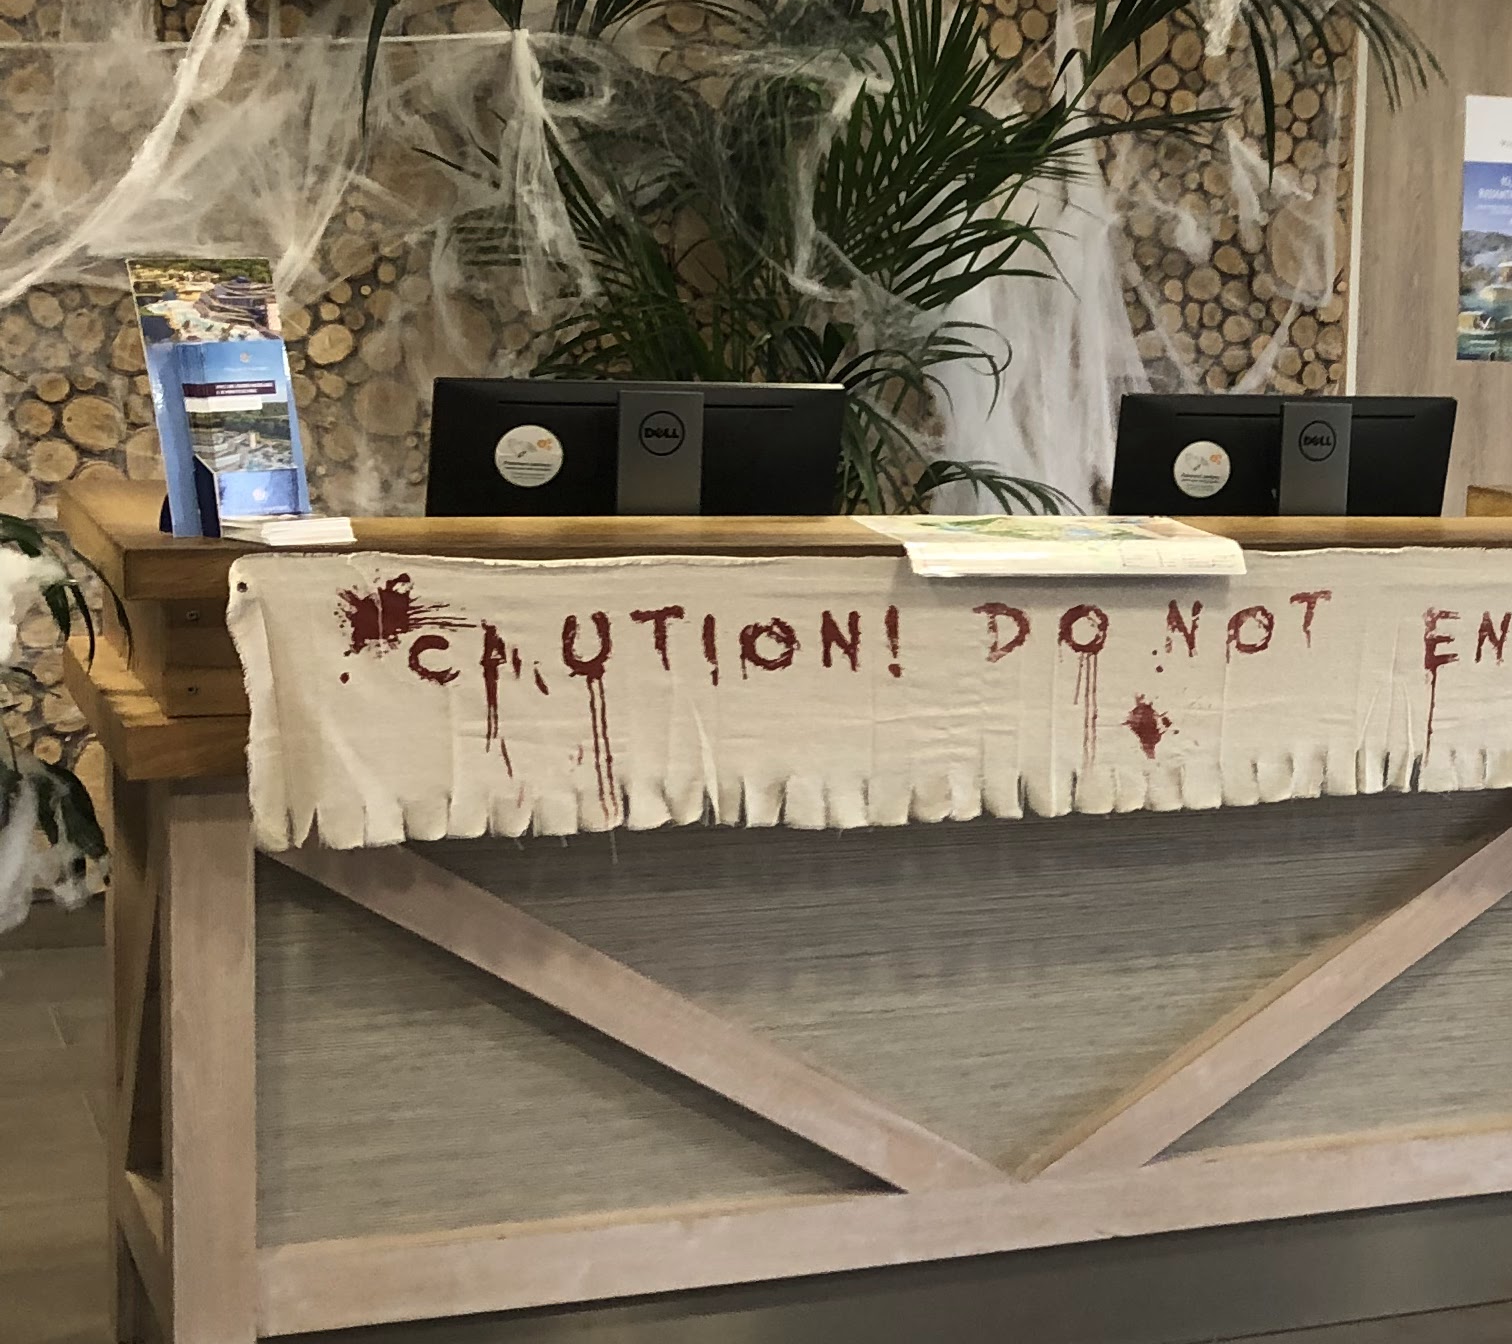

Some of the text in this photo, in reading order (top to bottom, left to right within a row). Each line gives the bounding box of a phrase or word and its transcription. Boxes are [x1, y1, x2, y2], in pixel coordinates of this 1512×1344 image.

[644, 427, 680, 439] DELL
[1303, 435, 1332, 446] DELL
[972, 601, 1111, 664] DO
[1164, 589, 1333, 663] NOT
